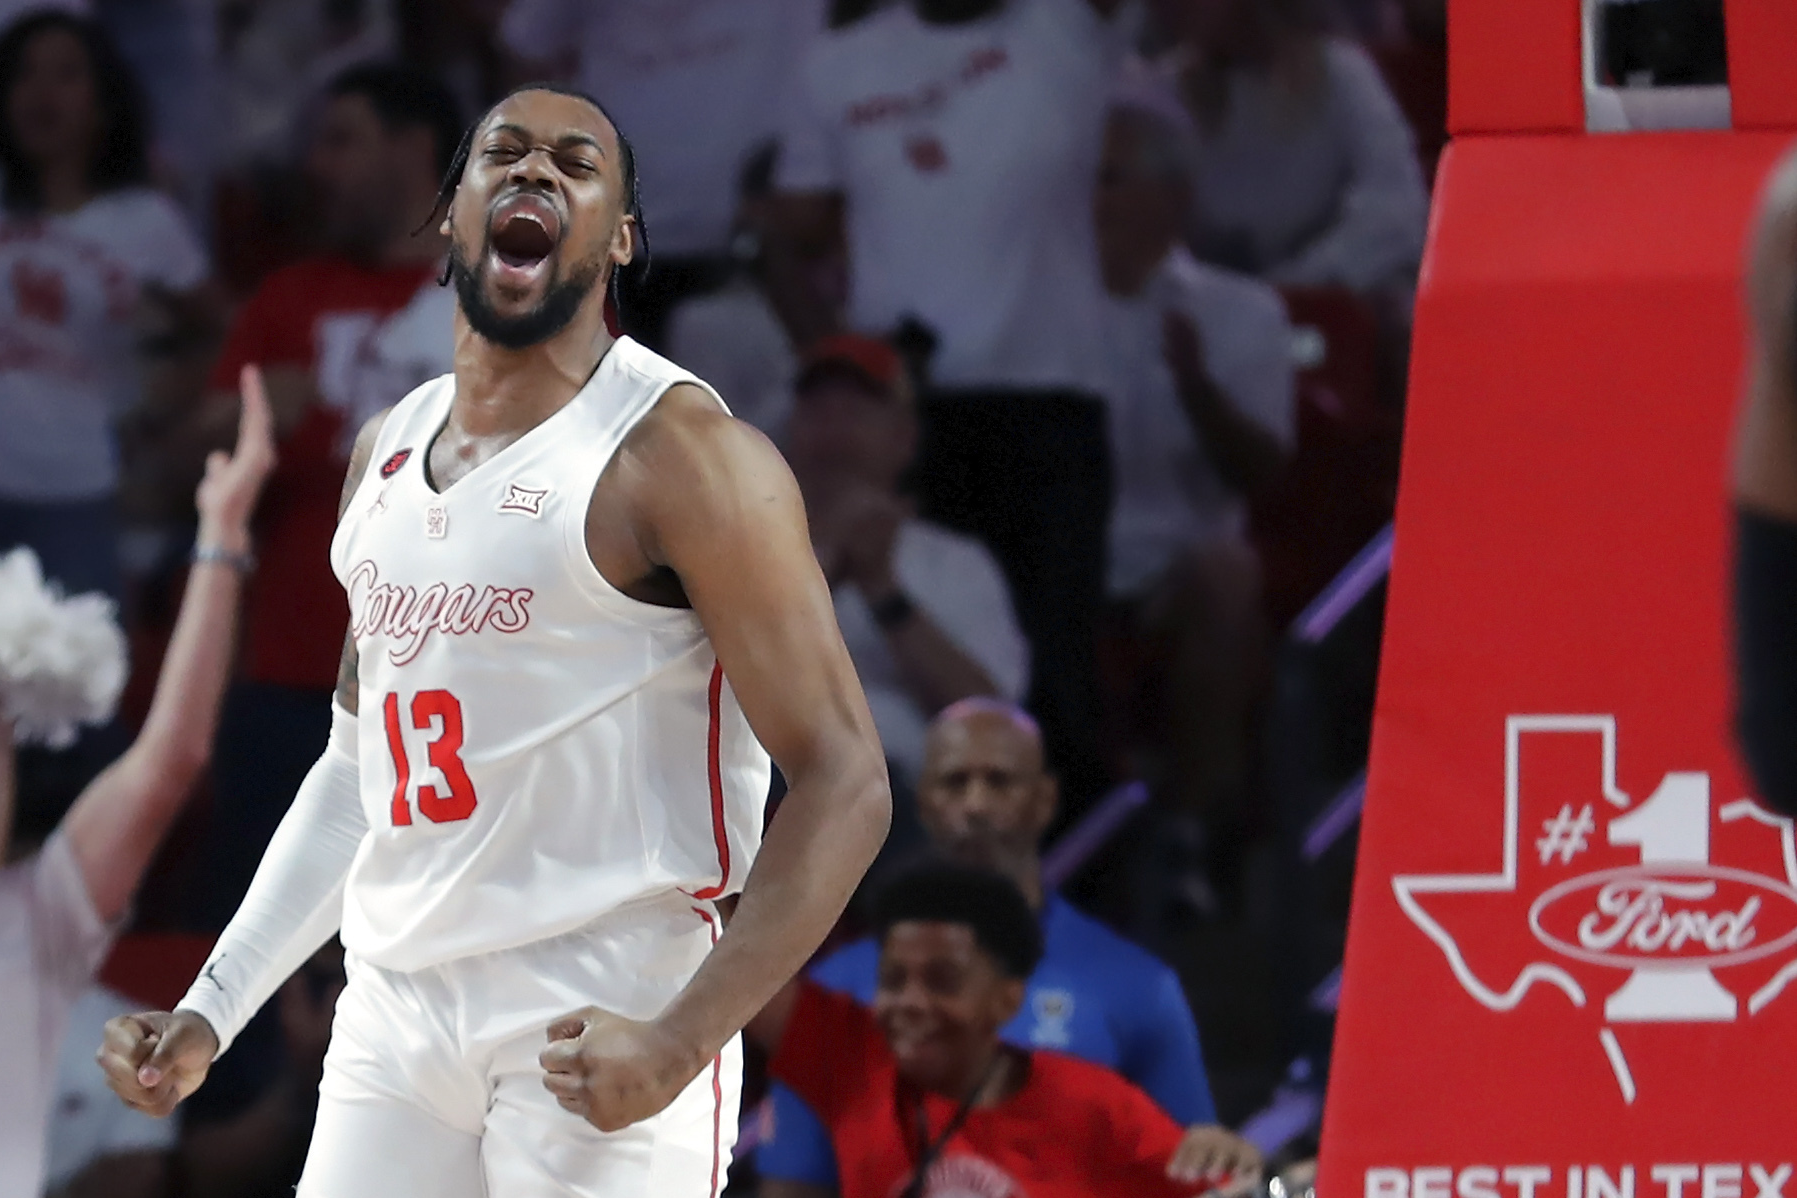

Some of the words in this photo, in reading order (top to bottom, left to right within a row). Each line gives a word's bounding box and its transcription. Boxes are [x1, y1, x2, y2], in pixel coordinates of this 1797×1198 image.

[347, 559, 534, 666] Cougars
[383, 689, 478, 827] 13
[1577, 877, 1762, 951] Ford
